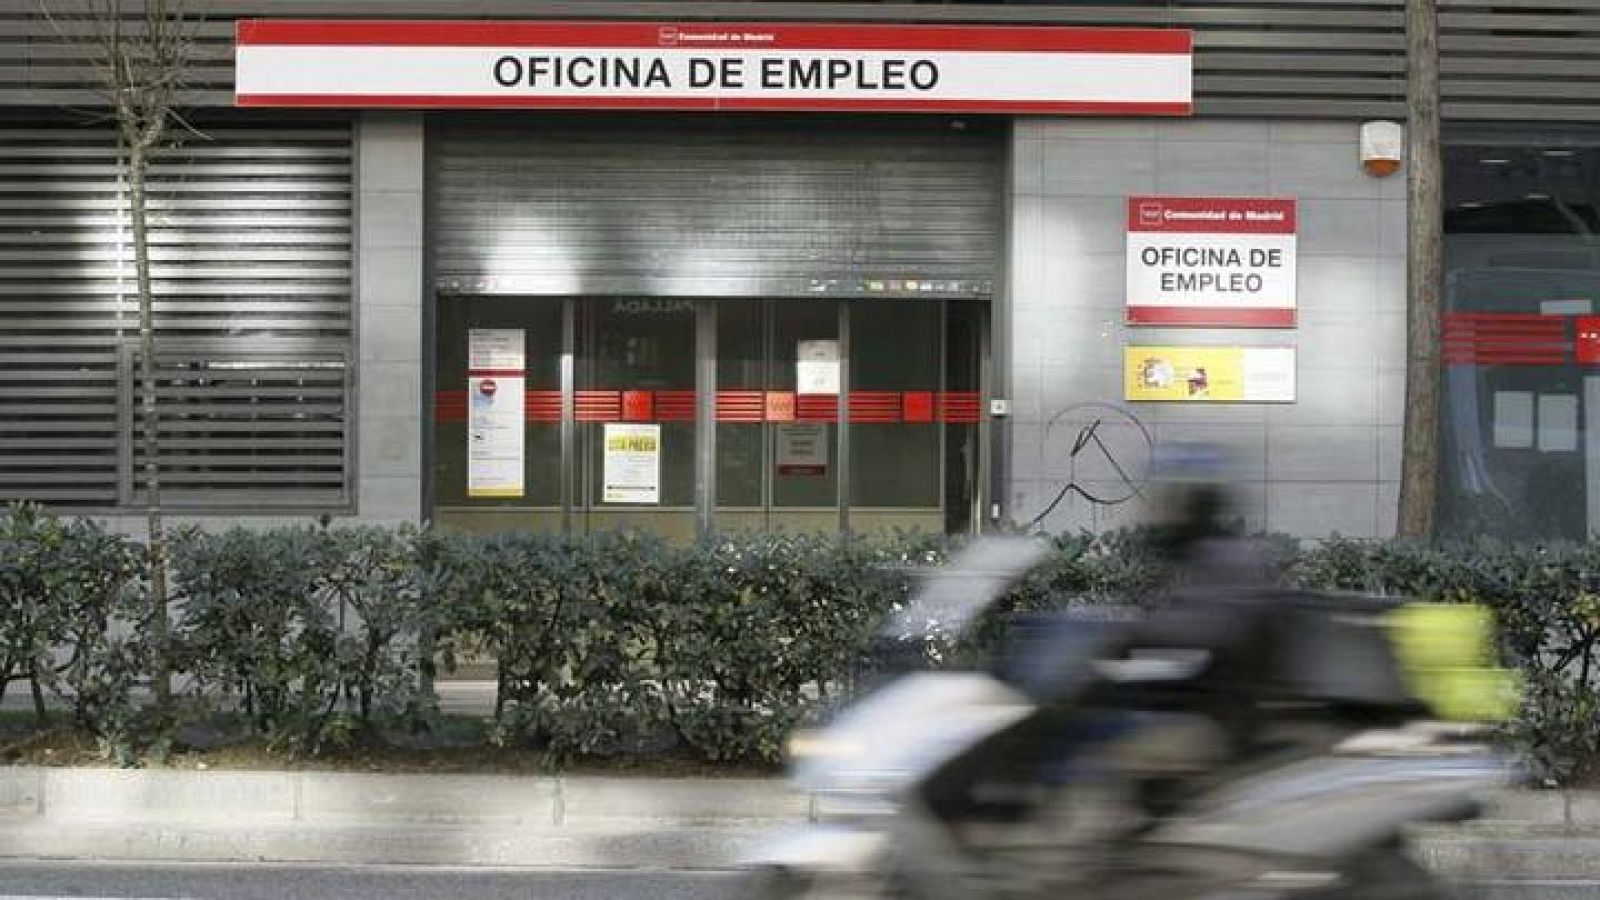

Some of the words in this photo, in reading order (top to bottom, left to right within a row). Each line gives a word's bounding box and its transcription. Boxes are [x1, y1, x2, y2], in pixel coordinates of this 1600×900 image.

[744, 32, 774, 41] Madrid
[493, 55, 672, 88] OFICINA
[688, 57, 744, 89] DE
[760, 58, 940, 91] EMPLEO
[1164, 208, 1227, 221] Comunidad
[1229, 209, 1243, 221] de
[1246, 209, 1284, 221] Madrid
[1141, 246, 1241, 268] OFICINA
[1250, 247, 1282, 268] DE
[1160, 273, 1263, 292] EMPLEO
